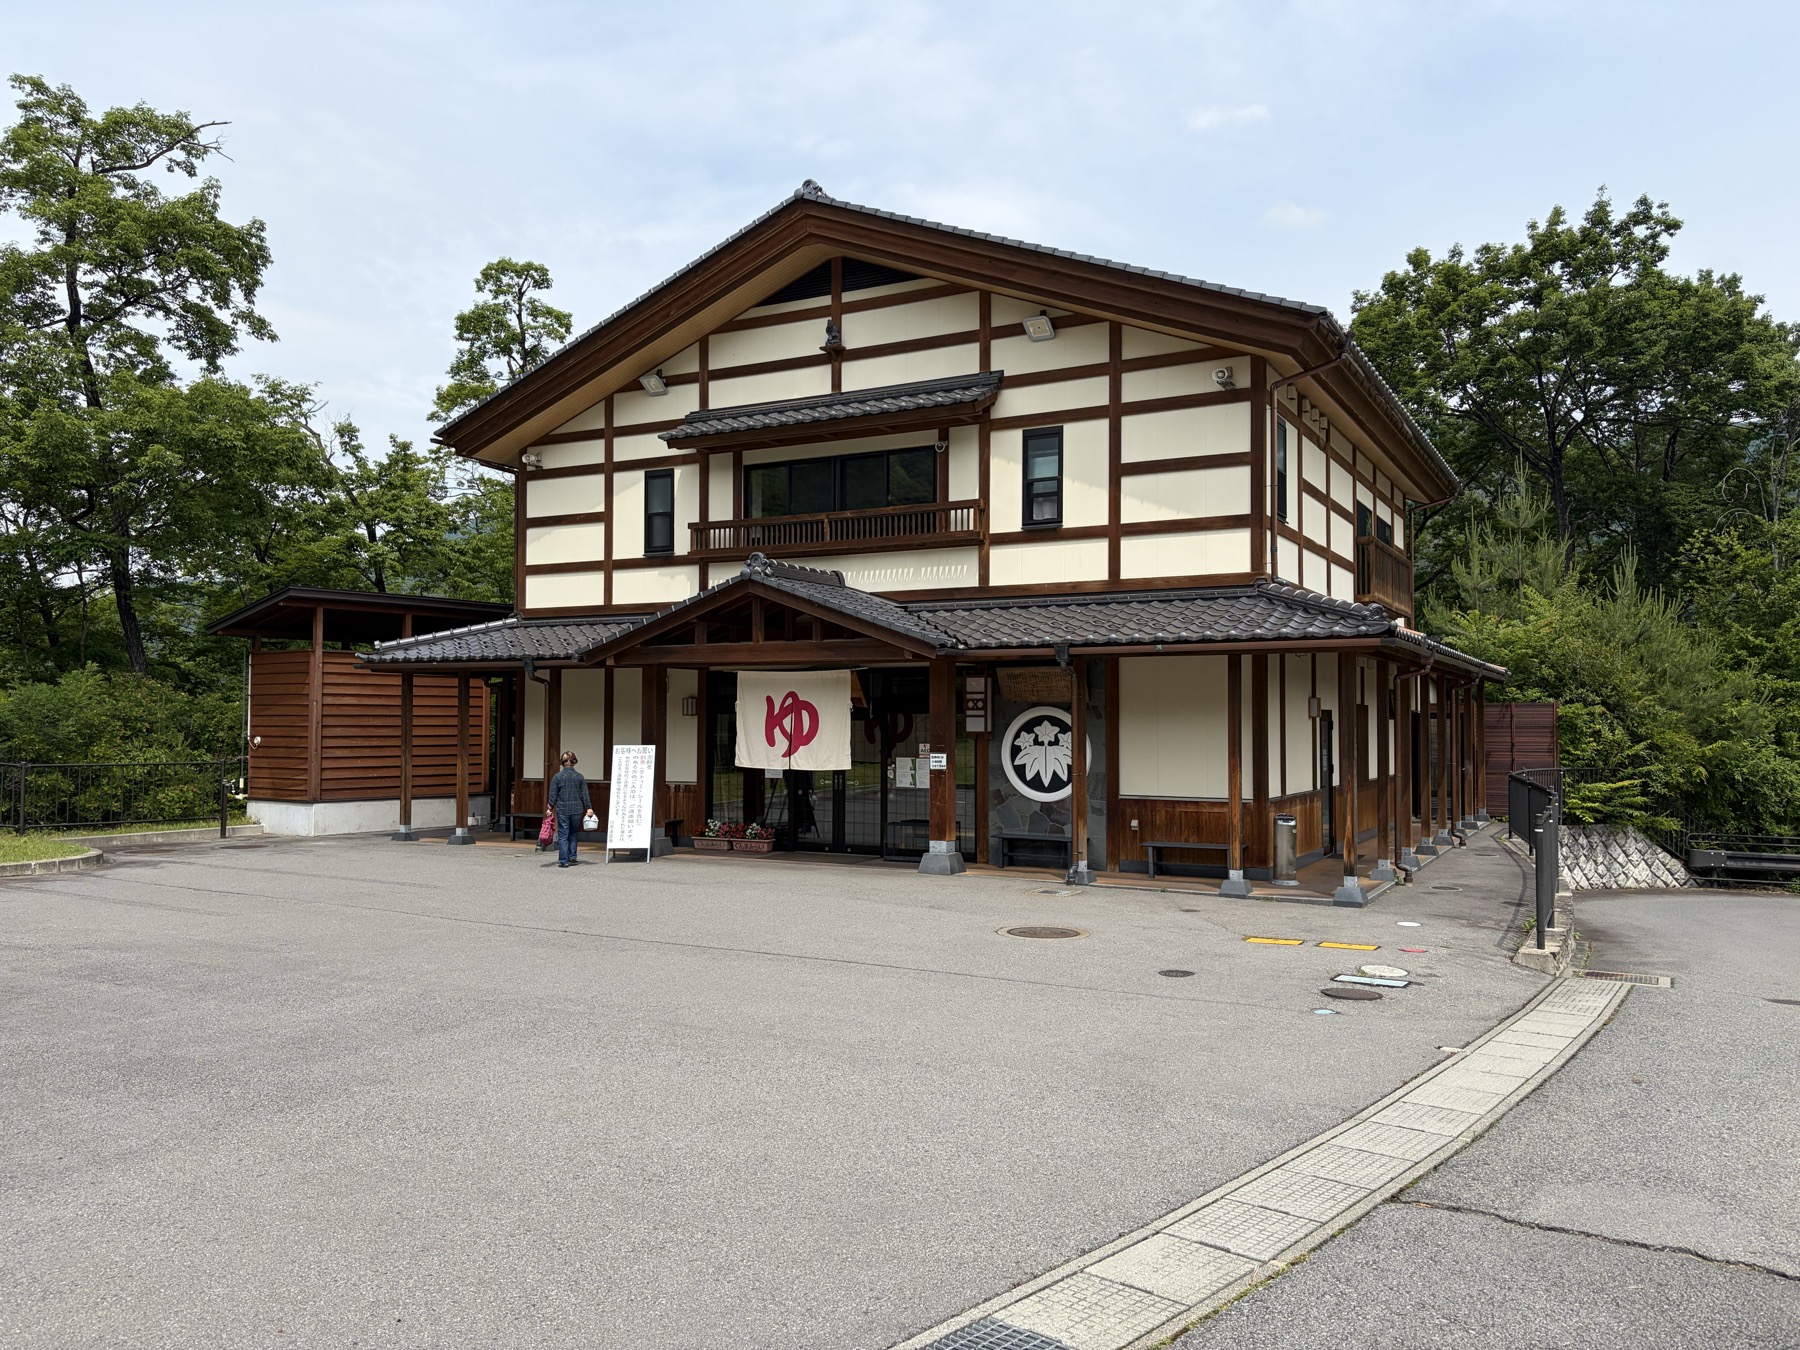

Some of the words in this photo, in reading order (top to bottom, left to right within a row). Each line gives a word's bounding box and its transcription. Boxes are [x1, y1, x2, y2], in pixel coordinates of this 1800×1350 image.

[765, 690, 820, 758] ゆ
[614, 746, 654, 755] お客様へお願い
